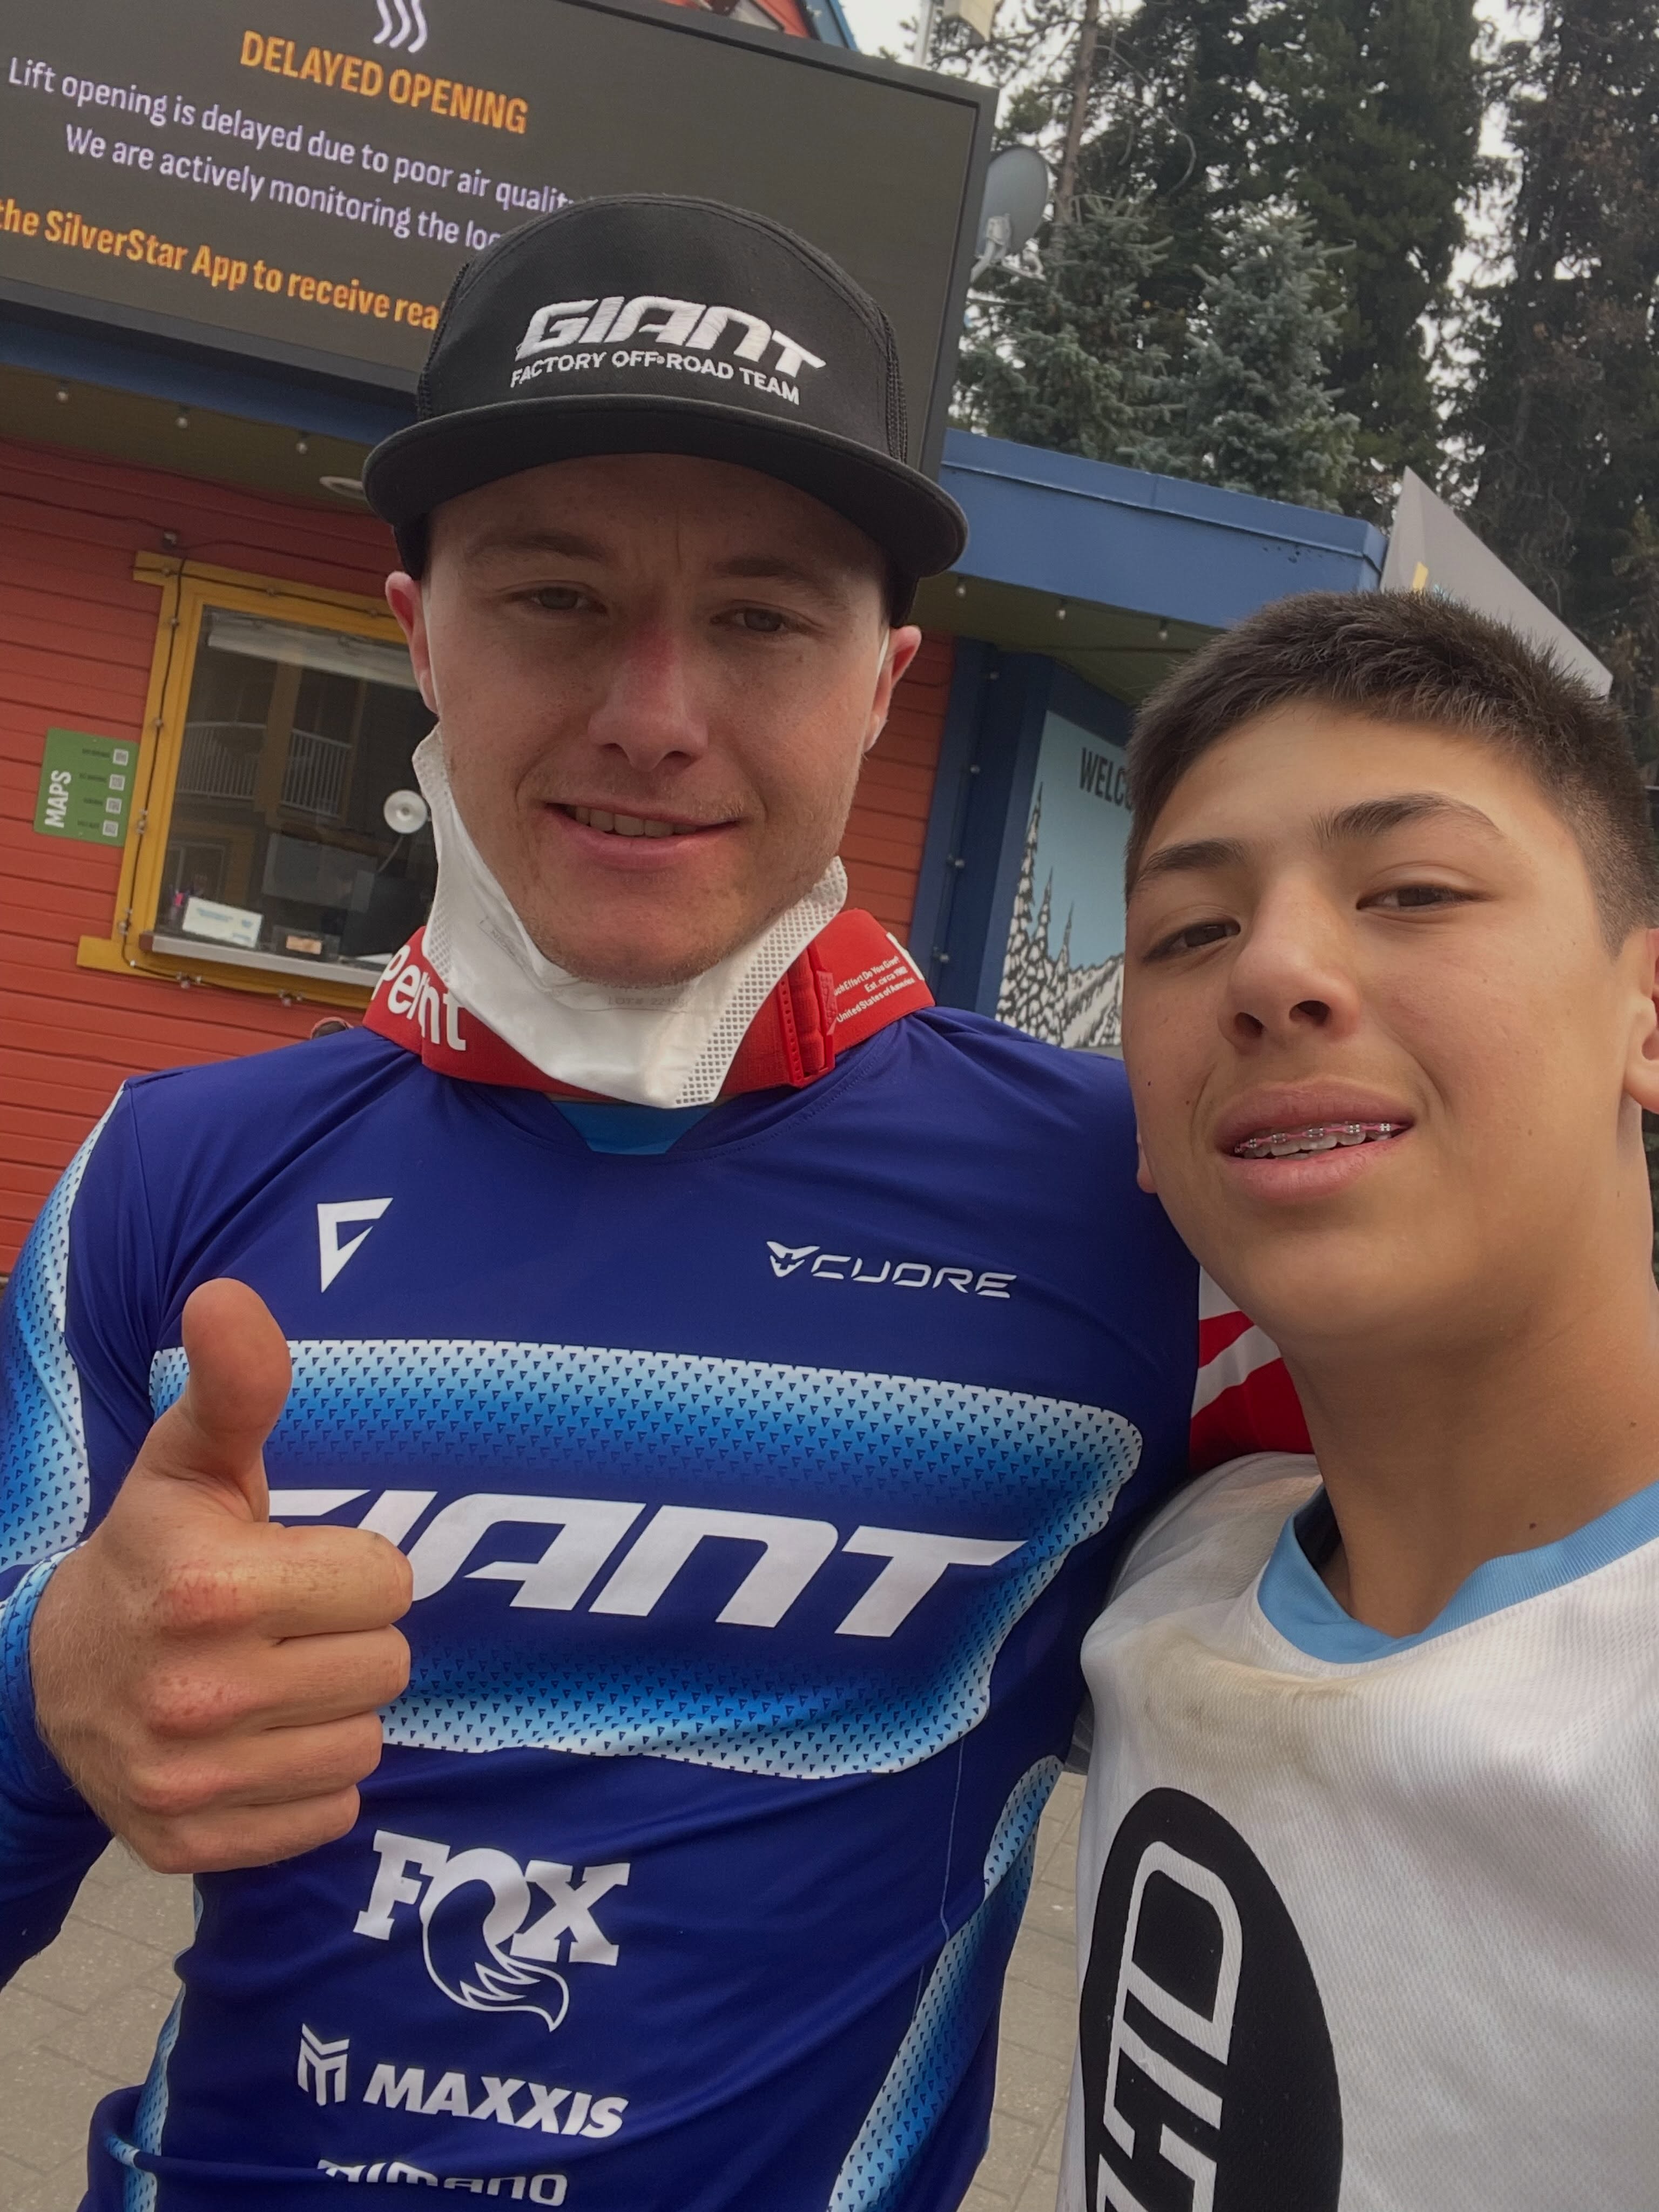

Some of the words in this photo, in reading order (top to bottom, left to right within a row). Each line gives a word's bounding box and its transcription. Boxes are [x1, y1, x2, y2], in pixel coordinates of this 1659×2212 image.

[240, 30, 383, 97] DELAYED
[389, 69, 528, 134] OPENING
[9, 57, 56, 92] Lift
[62, 76, 168, 127] opening
[173, 95, 196, 125] is
[201, 104, 304, 151] delayed
[308, 130, 355, 164] due
[361, 144, 389, 173] to
[393, 157, 454, 184] poor
[457, 168, 491, 197] air
[495, 182, 575, 213] qualit
[66, 124, 106, 158] We
[112, 141, 154, 170] are
[160, 153, 265, 202] actively
[269, 179, 411, 239] monitoring
[417, 211, 460, 244] the
[45, 209, 188, 271] SilverStar
[191, 245, 249, 291] App
[253, 259, 284, 293] to
[287, 273, 390, 319] receive
[515, 295, 827, 378] GIANT
[510, 351, 608, 388] FACTORY
[739, 367, 800, 406] TEAM
[44, 770, 72, 828] MAPS
[836, 1004, 862, 1023] United
[859, 992, 885, 1010] States
[882, 986, 892, 996] of
[843, 975, 865, 990] Effort
[861, 970, 873, 980] Do
[870, 966, 886, 975] You
[811, 1253, 1017, 1299] CUORE
[353, 1829, 631, 2032] FOX
[363, 2063, 629, 2139] MAXXIS
